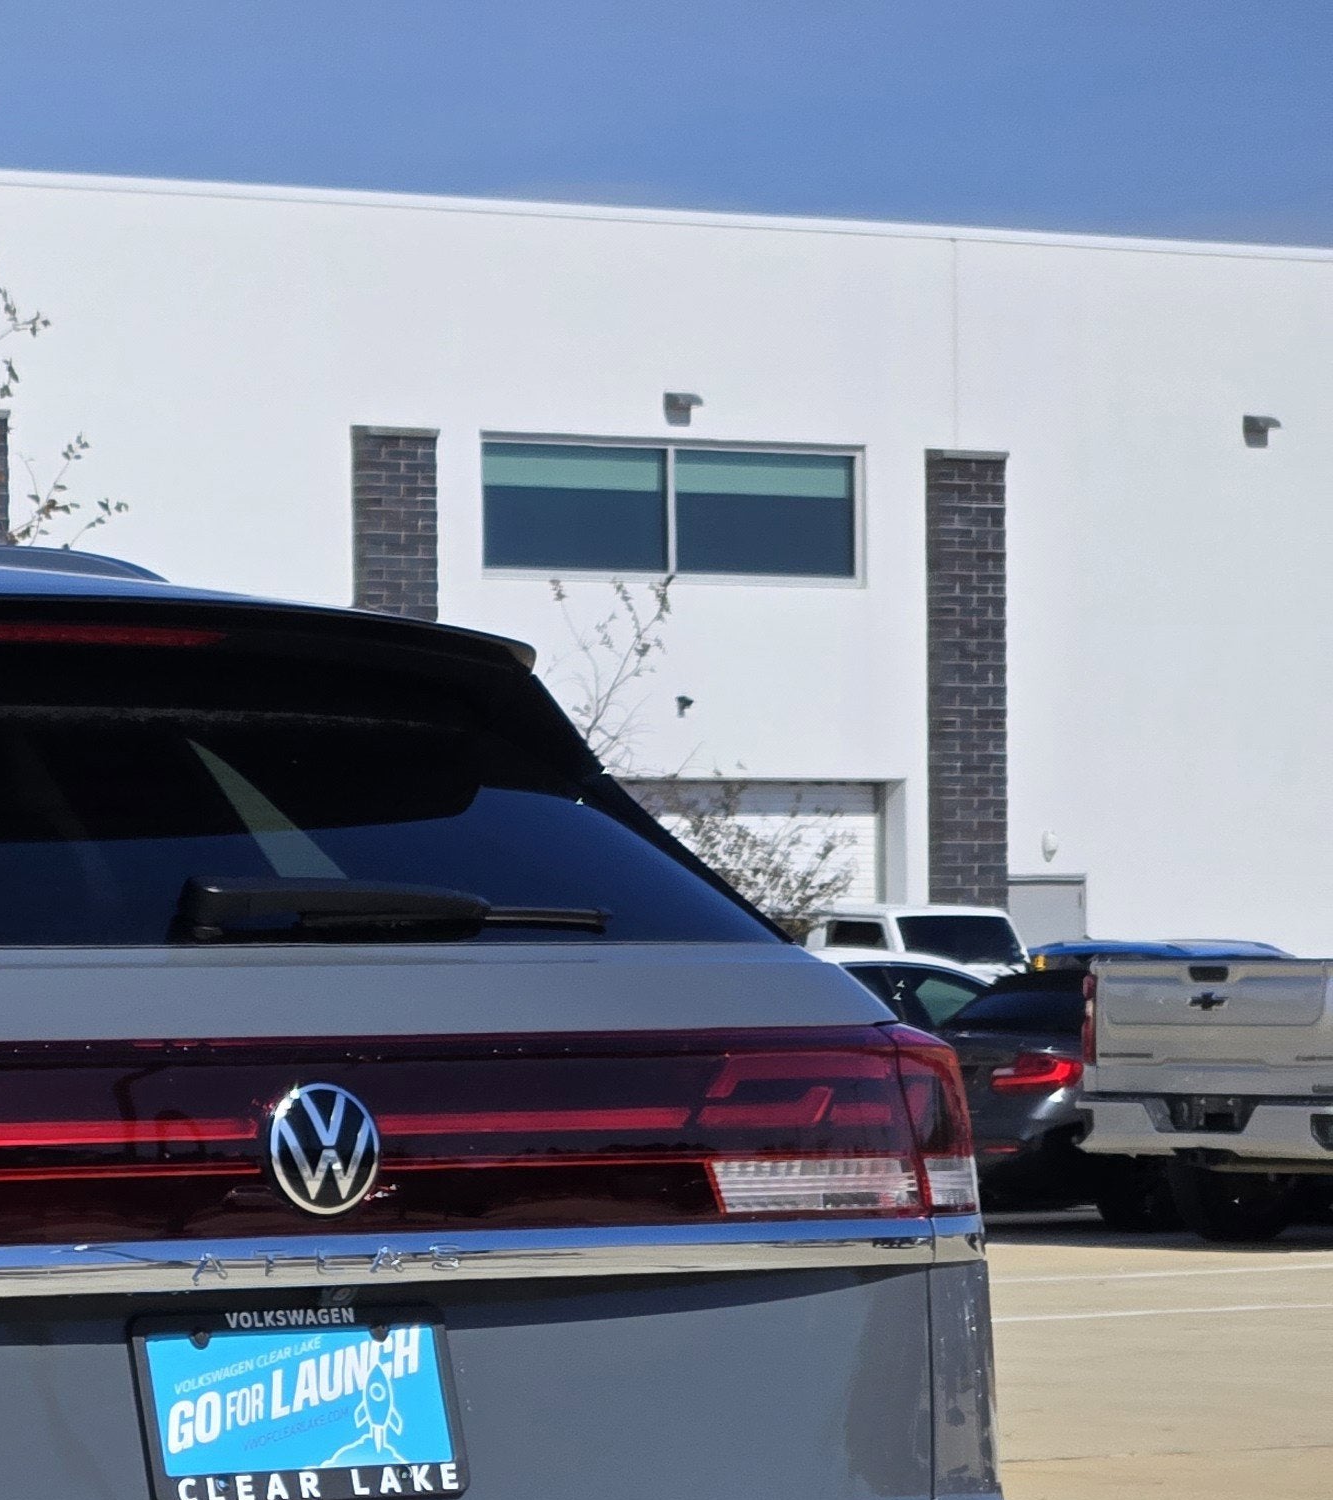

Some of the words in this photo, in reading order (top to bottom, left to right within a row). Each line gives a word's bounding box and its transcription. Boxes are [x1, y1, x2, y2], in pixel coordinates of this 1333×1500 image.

[273, 1085, 378, 1211] VW
[192, 1243, 460, 1286] ATLAS
[225, 1307, 355, 1329] VOLKSWAGEN
[168, 1390, 221, 1454] GO
[226, 1382, 264, 1431] FOR
[271, 1324, 420, 1420] LAUNCH
[173, 1359, 255, 1396] VOLKSWAGEN
[255, 1346, 293, 1369] CLEAR
[293, 1336, 322, 1356] LAKE
[350, 1463, 460, 1497] LAKE
